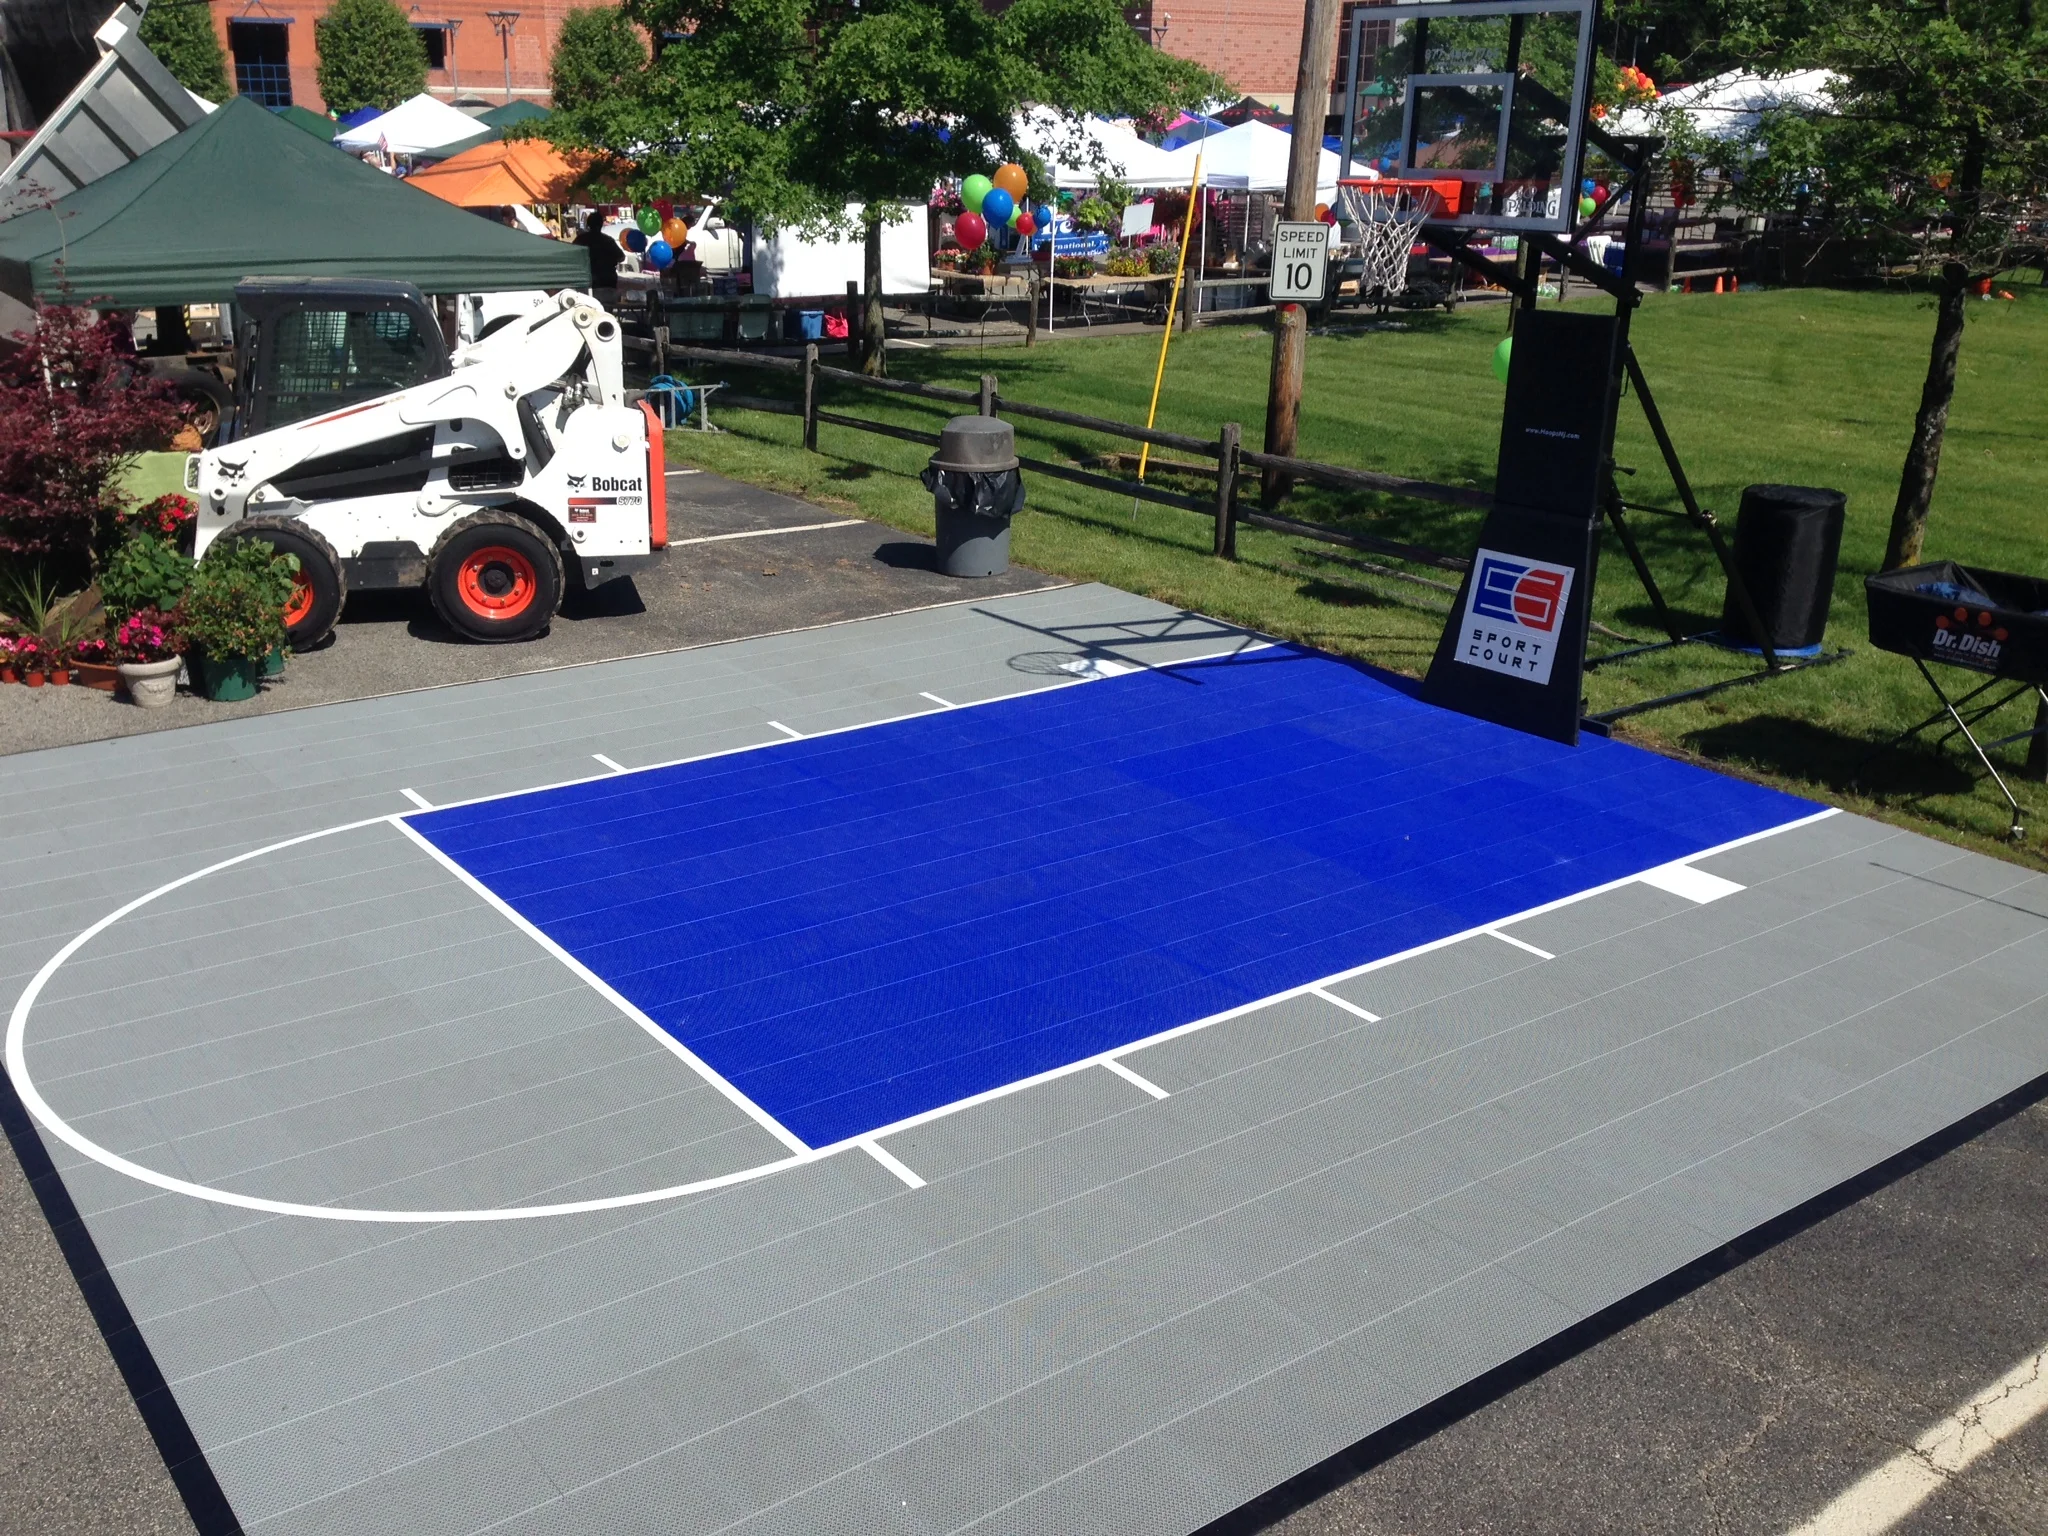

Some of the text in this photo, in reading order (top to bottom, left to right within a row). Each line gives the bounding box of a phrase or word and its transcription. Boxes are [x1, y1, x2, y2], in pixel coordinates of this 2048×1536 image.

[1280, 231, 1324, 242] SPEED
[1283, 247, 1318, 258] LIMIT
[1286, 262, 1312, 290] 10
[592, 477, 642, 491] Bobcat
[618, 496, 642, 505] S770
[1472, 629, 1541, 656] SPORT
[1932, 628, 1957, 649] Dr.
[1958, 633, 2001, 658] Dish
[1469, 644, 1538, 672] COURT
